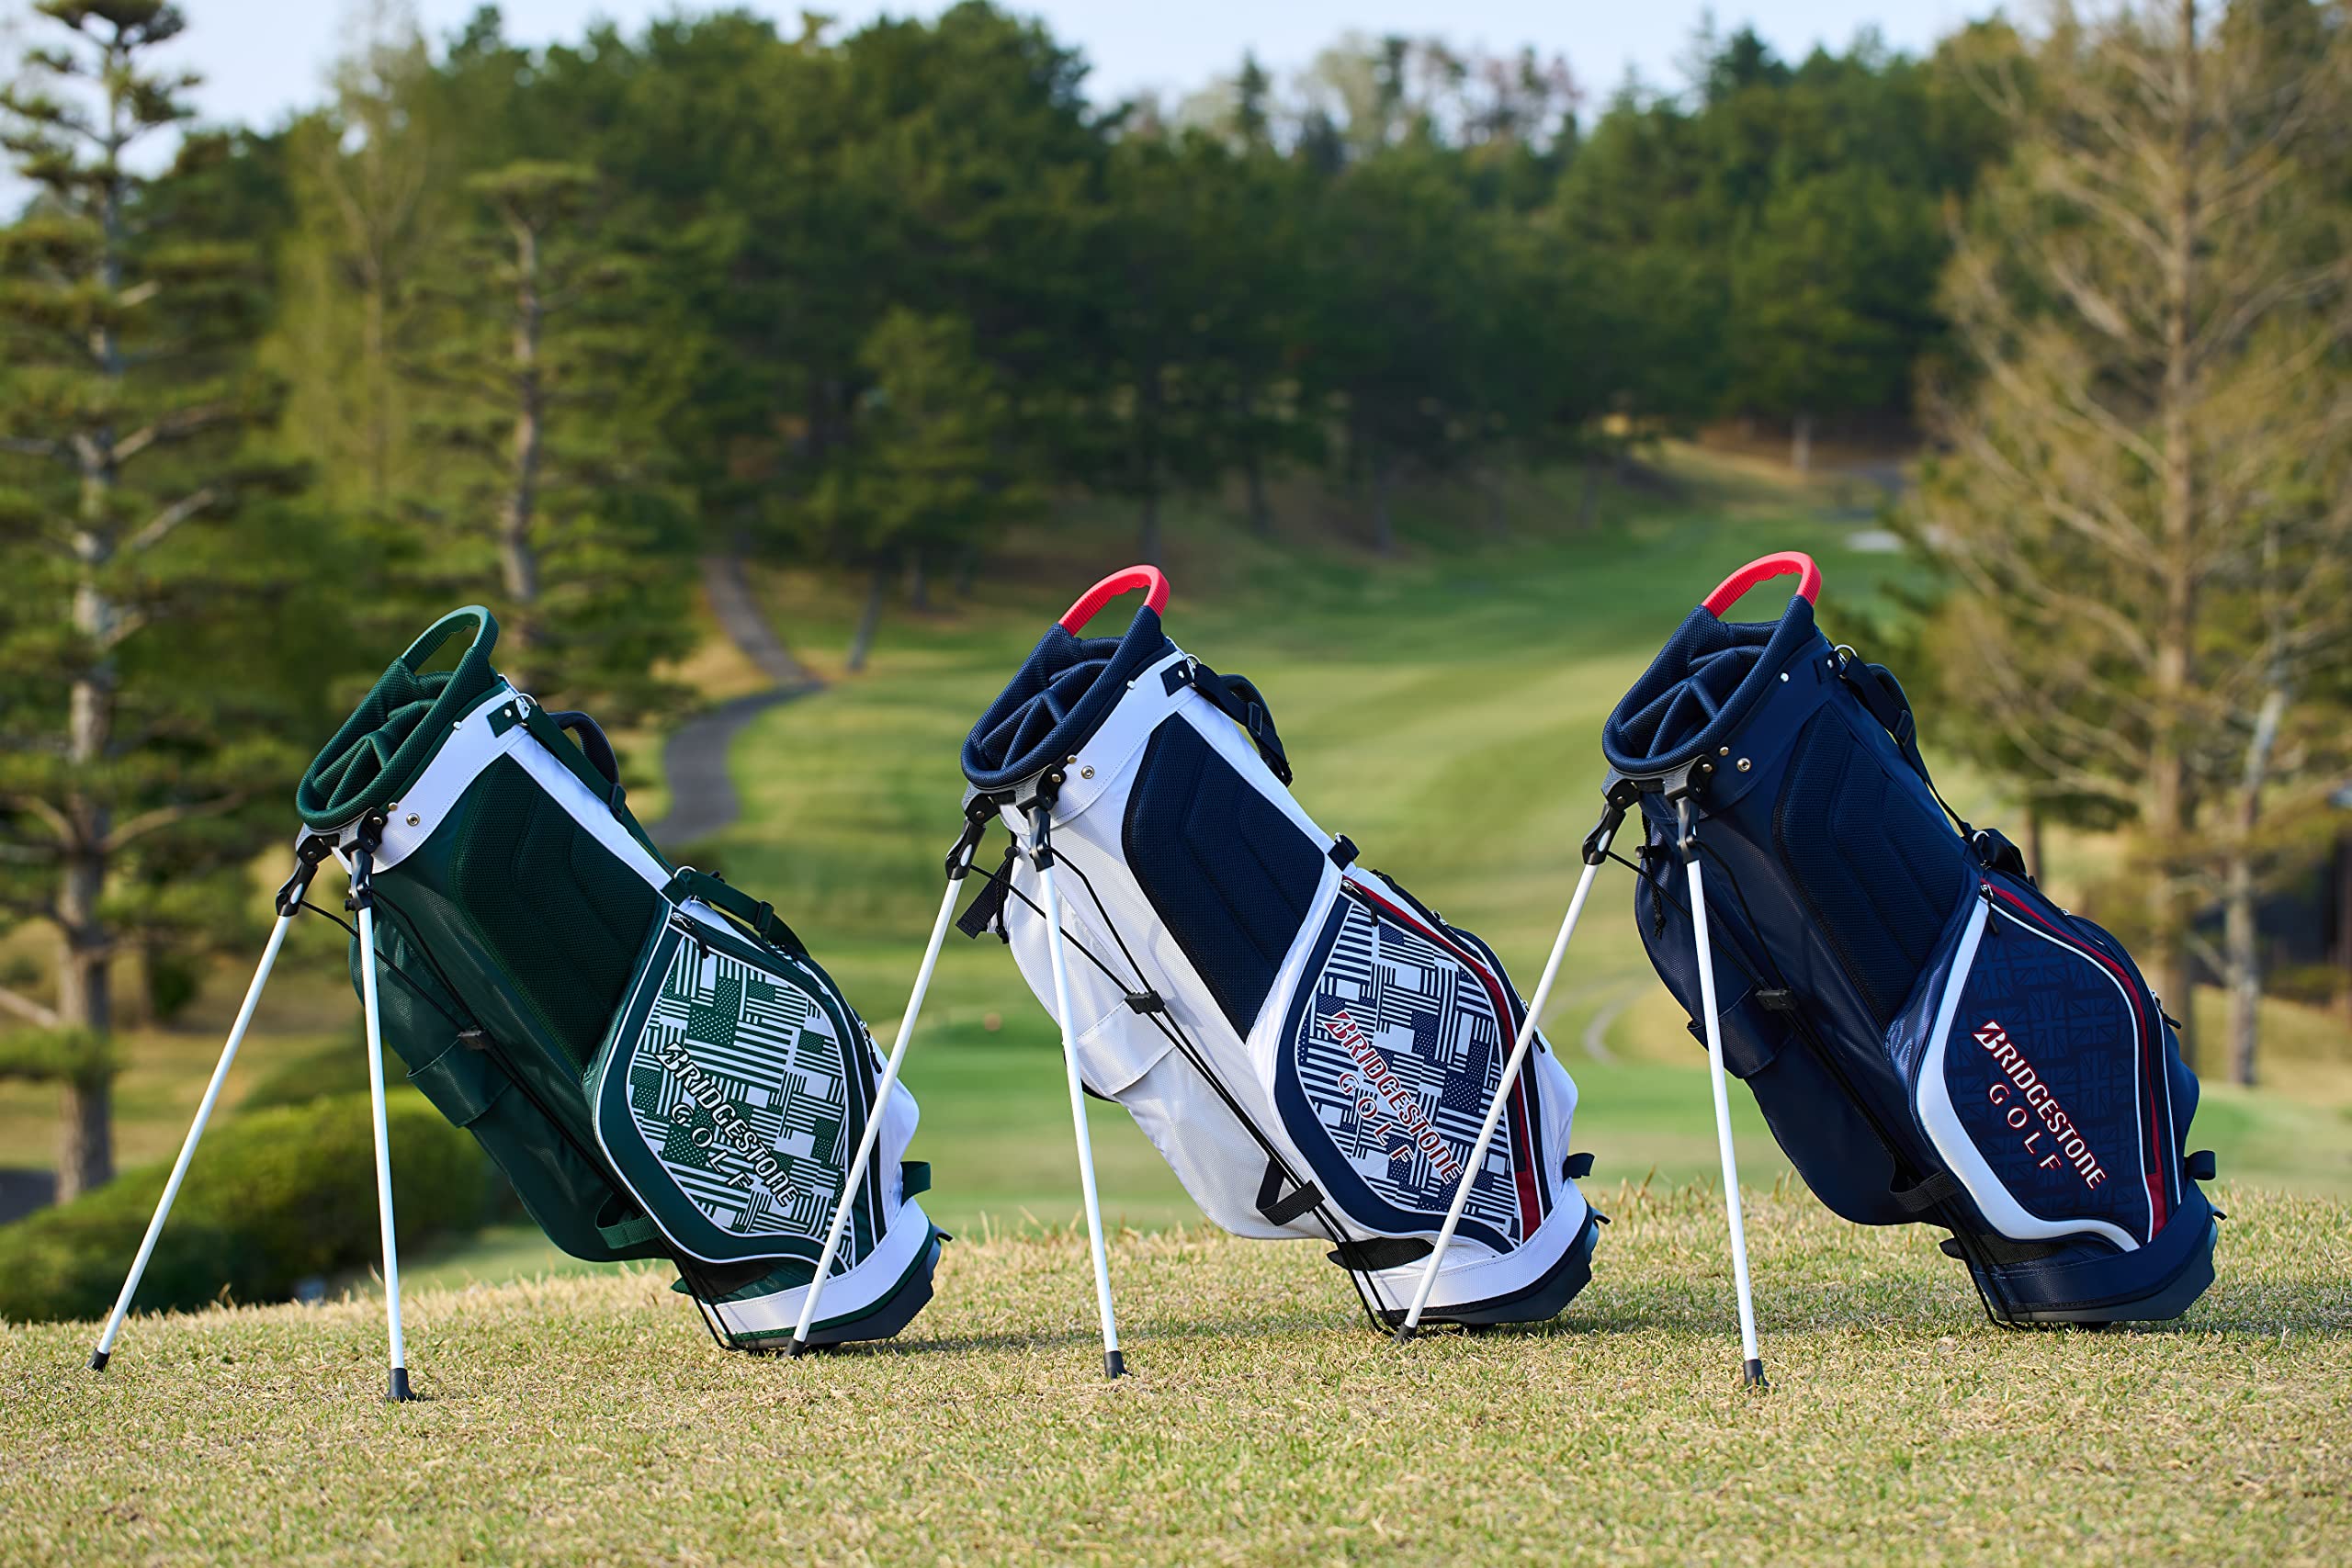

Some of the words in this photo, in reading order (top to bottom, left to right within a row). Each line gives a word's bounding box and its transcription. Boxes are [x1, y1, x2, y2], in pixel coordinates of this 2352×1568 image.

[653, 1042, 799, 1207] BRIDGESTONE
[671, 1103, 753, 1190] GOLF
[1322, 1011, 1464, 1184] BRIDGESTONE
[1338, 1072, 1415, 1164] GOLF
[1972, 1020, 2108, 1190] BRIDGESTONE
[1988, 1083, 2062, 1171] GOLF
